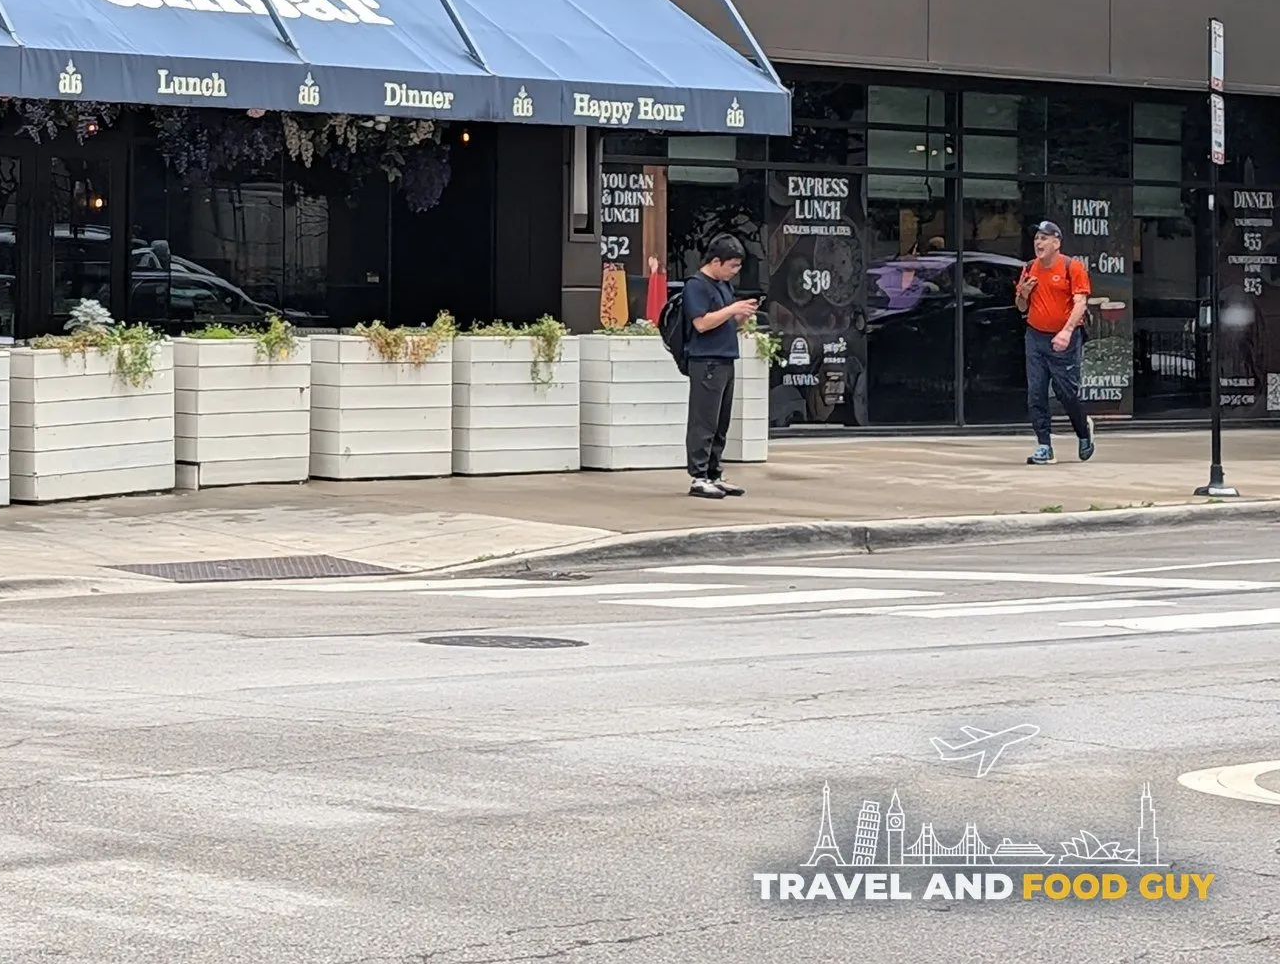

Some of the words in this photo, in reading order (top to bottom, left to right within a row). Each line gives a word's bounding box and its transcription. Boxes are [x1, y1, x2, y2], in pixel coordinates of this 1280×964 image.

[157, 68, 228, 98] Lunch
[384, 82, 454, 110] Dinner
[573, 92, 635, 124] Happy
[637, 96, 686, 123] Hour
[602, 173, 627, 189] YOU
[629, 174, 654, 189] CAN
[788, 176, 849, 198] EXPRESS
[602, 189, 613, 206] &
[615, 190, 655, 207] DRINK
[1072, 199, 1110, 217] HAPPY
[1234, 190, 1274, 209] DINNER
[795, 199, 841, 220] LUNCH
[1073, 218, 1109, 236] HOUR
[1098, 252, 1124, 274] 6PM
